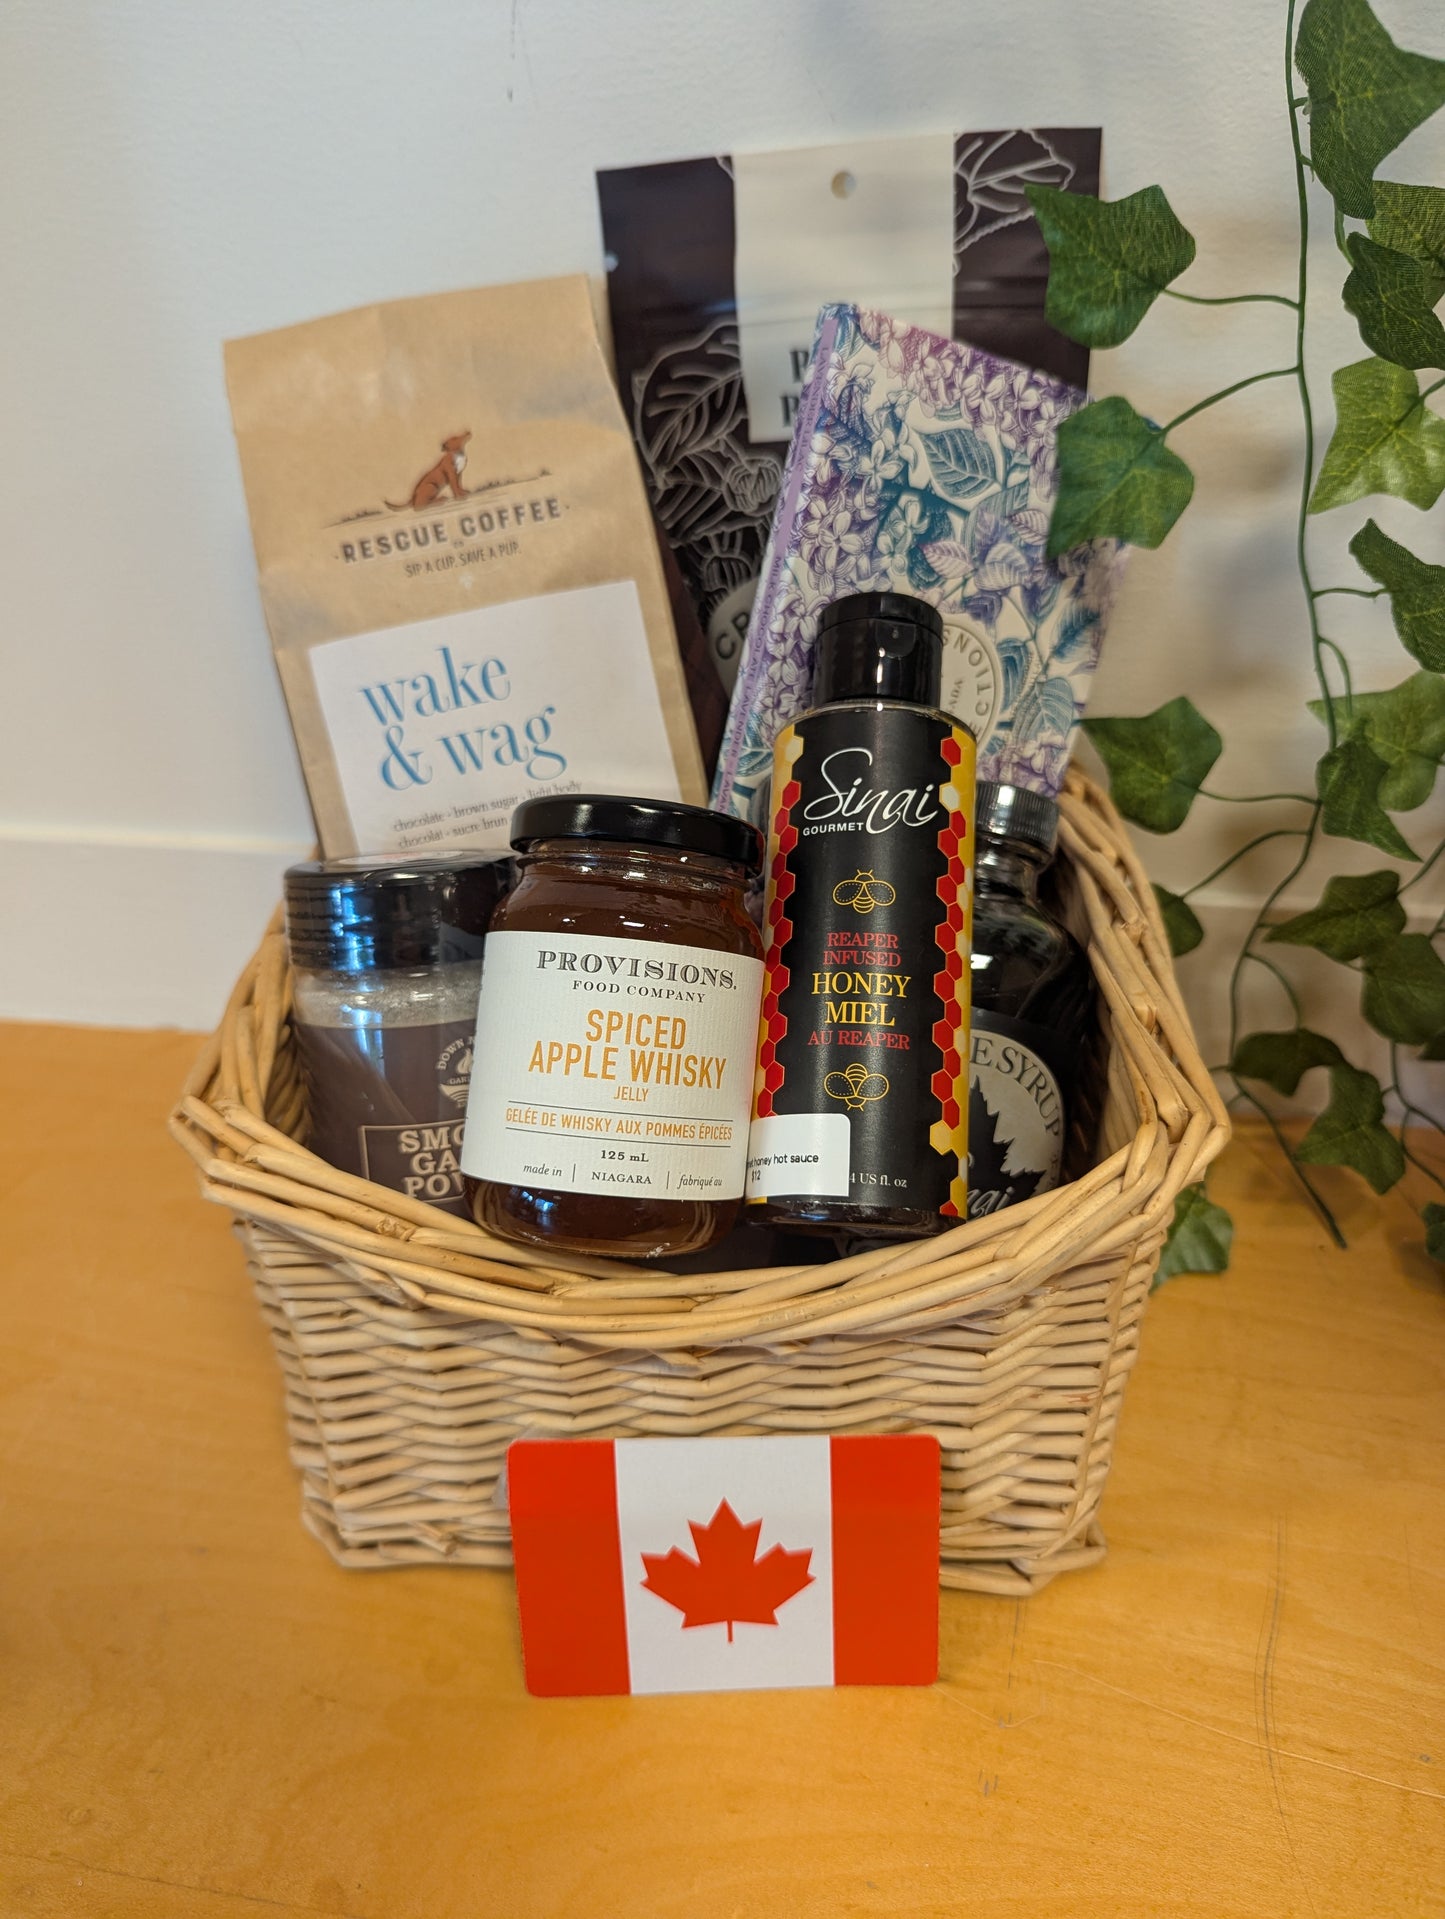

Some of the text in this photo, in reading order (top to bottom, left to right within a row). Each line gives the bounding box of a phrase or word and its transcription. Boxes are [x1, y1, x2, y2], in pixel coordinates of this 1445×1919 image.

[341, 497, 562, 564] RESCUE COFFEE
[405, 562, 422, 578] SIP
[459, 549, 485, 567] SAVE
[358, 647, 511, 726] wake
[380, 706, 567, 791] & wag
[804, 747, 938, 834] Sinai
[393, 809, 446, 832] chocolate
[452, 801, 491, 819] brown
[491, 795, 519, 813] sugar
[398, 816, 508, 849] chocolat sucre brun
[802, 821, 865, 836] GOURMET
[827, 932, 899, 949] REAPER
[823, 950, 902, 968] INFUSED
[572, 980, 706, 1004] FOOD COMPANY
[811, 971, 911, 998] HONEY
[824, 1001, 896, 1027] MIEL
[585, 1009, 687, 1050] SPICED
[807, 1030, 911, 1051] AU REAPER
[528, 1040, 727, 1090] APPLE WHISKY
[613, 1086, 649, 1102] JELLY
[995, 1045, 1061, 1137] SYRUP
[506, 1107, 733, 1141] GELÉE DE WHISKY AUX POMMES ÉPICÉES
[600, 1150, 649, 1162] 125 mL
[753, 1156, 772, 1168] honey
[773, 1153, 788, 1164] hot
[790, 1154, 819, 1164] sauce
[523, 1163, 562, 1177] made in
[591, 1171, 652, 1185] NIAGARA
[676, 1173, 722, 1190] fabriqué au
[859, 1172, 877, 1185] US
[880, 1173, 891, 1187] fl.
[894, 1178, 908, 1189] oz
